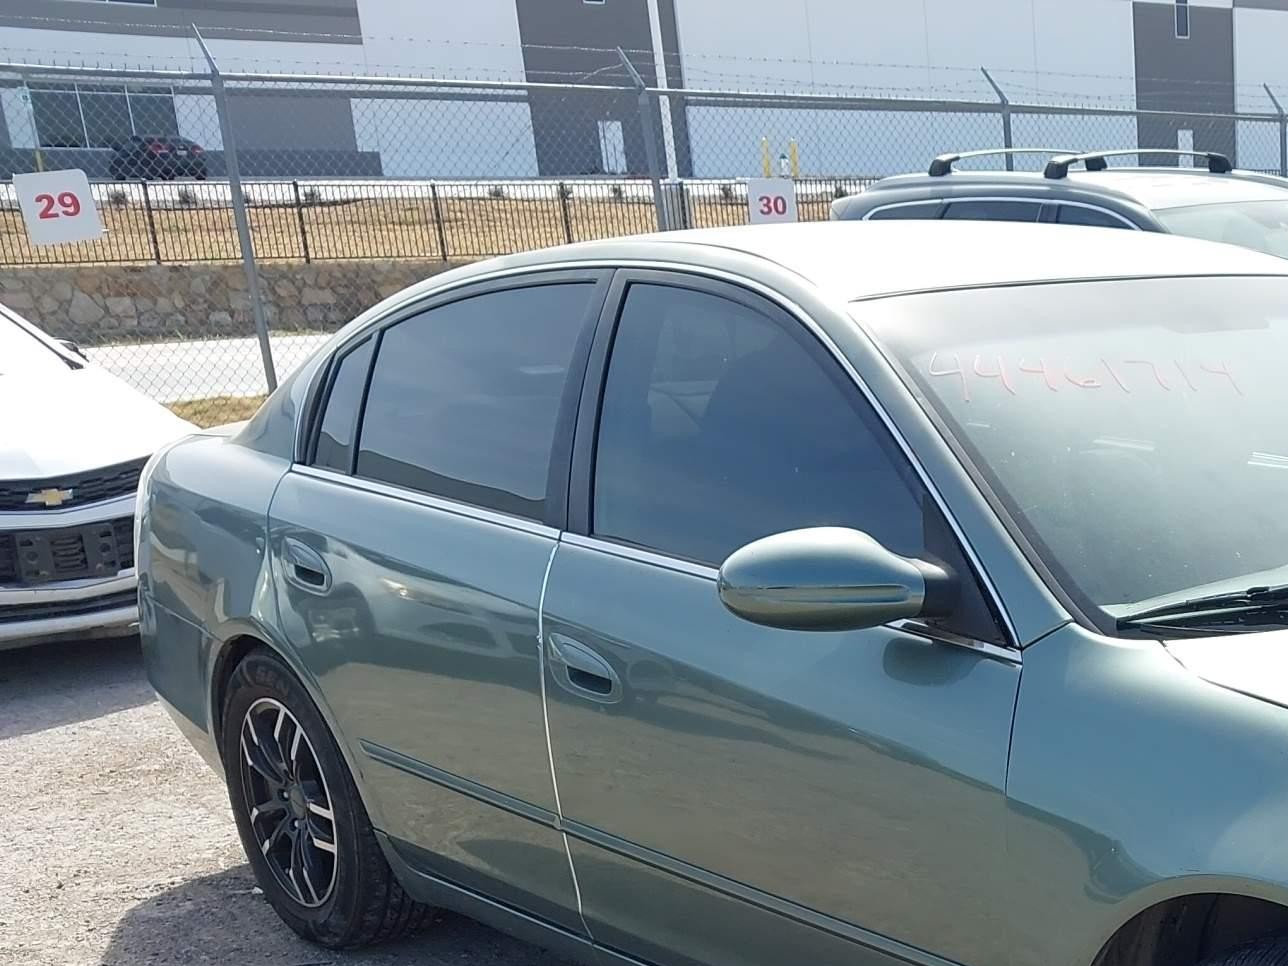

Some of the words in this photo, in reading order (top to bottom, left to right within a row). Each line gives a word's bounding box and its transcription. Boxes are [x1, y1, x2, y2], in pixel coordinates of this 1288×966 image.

[34, 191, 81, 219] 29
[758, 195, 787, 215] 30
[928, 351, 1244, 403] 44461714
